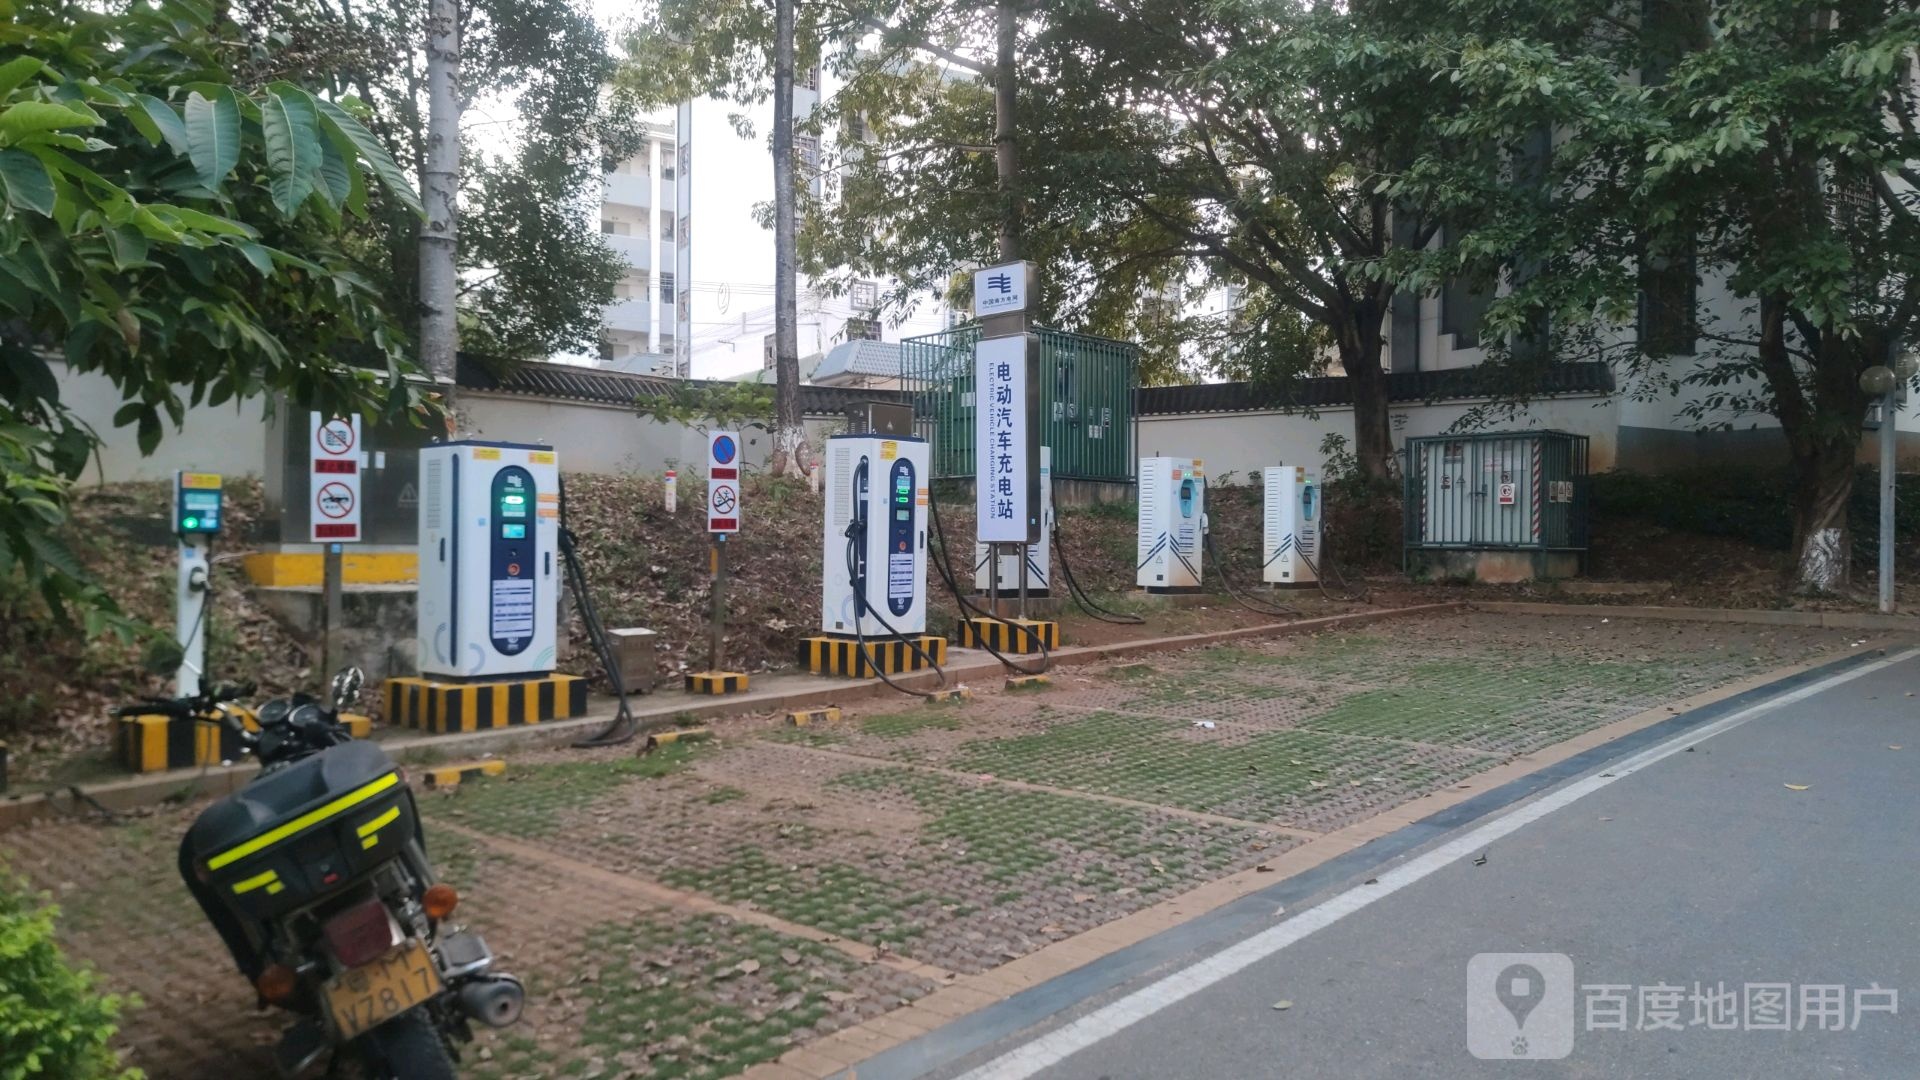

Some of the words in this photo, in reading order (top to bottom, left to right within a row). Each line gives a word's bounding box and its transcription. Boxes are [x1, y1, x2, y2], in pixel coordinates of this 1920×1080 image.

[996, 361, 1013, 520] 电动汽车充电站
